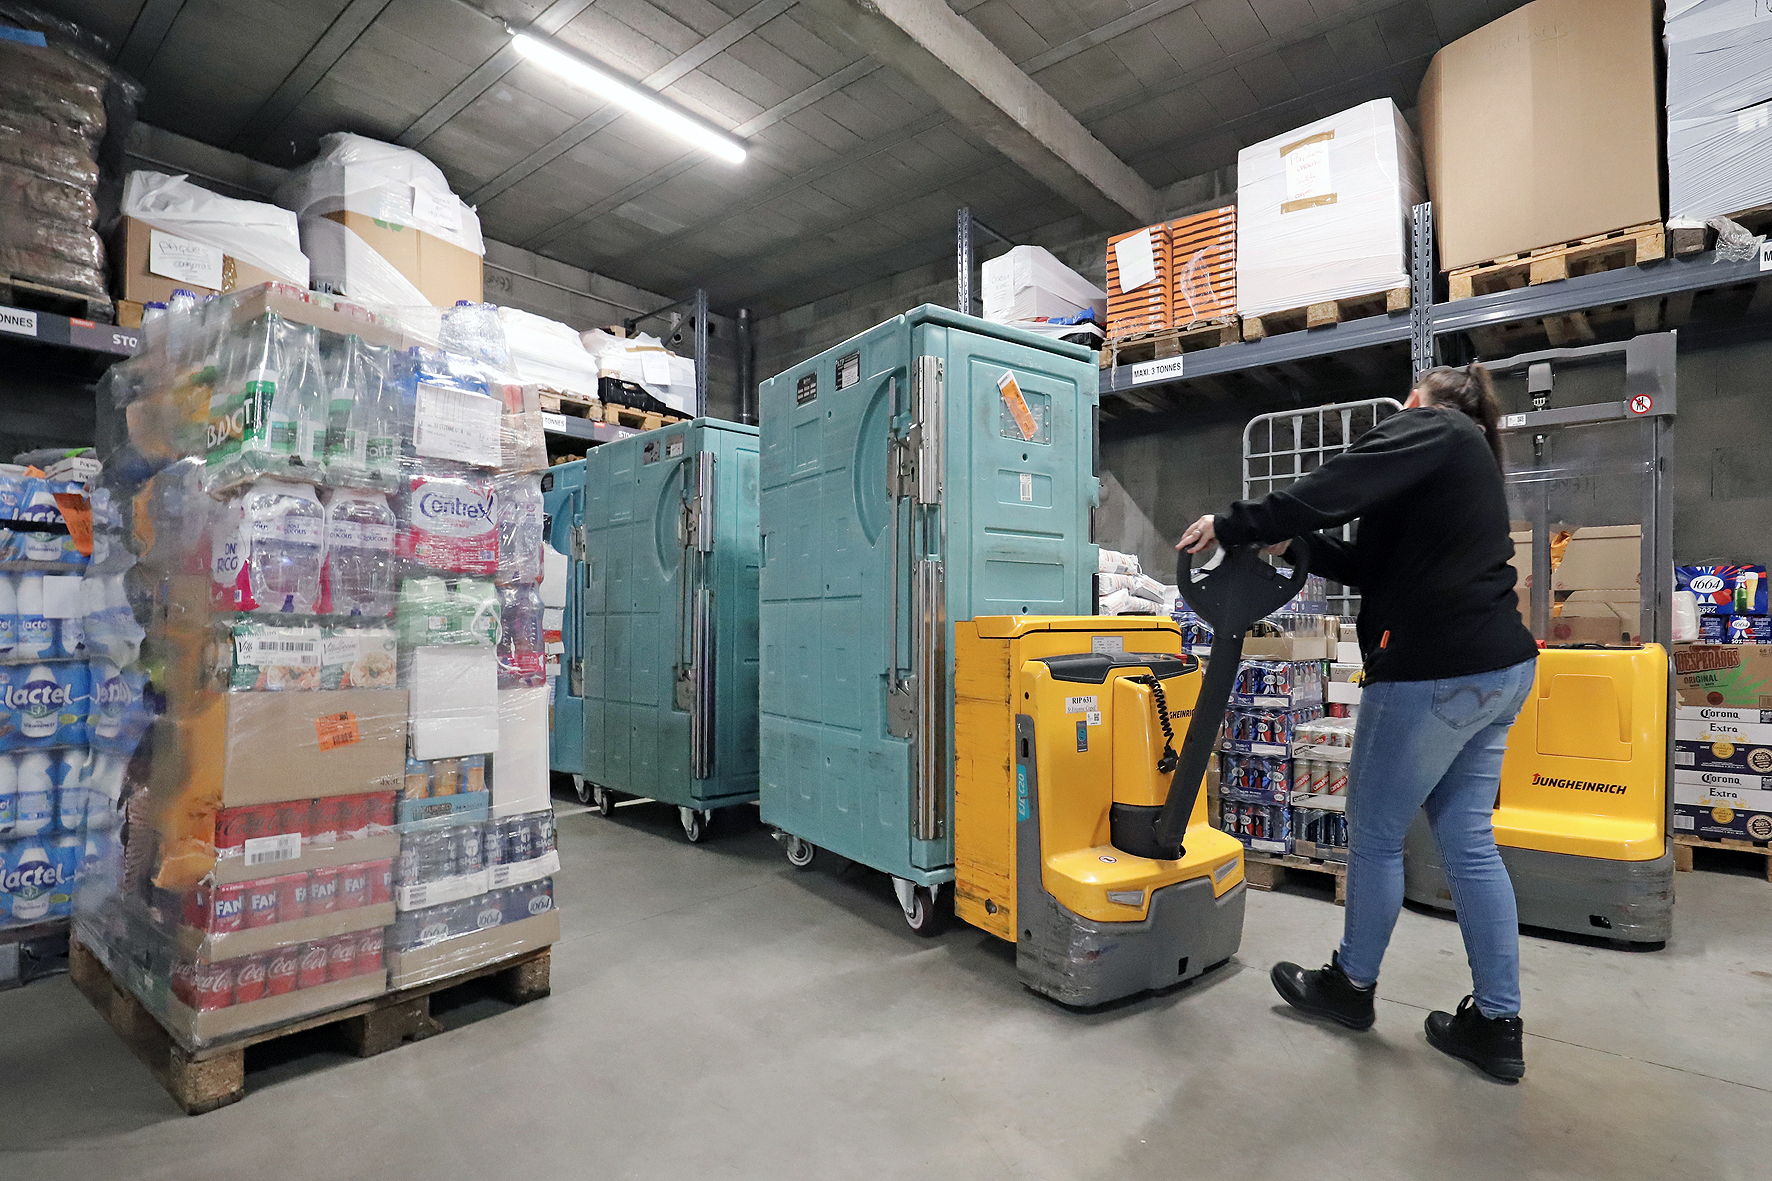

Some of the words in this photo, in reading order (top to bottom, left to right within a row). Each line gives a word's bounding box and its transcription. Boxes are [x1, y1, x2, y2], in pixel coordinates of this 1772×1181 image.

[1151, 367, 1156, 375] 3
[1156, 362, 1182, 374] TONNES
[1692, 580, 1721, 590] 1664
[1677, 650, 1740, 673] DESPERADOS
[1683, 673, 1719, 684] ORIGINAL
[5, 683, 73, 709] lactel
[1072, 697, 1082, 705] RIP
[1700, 708, 1741, 719] Corona
[1709, 723, 1738, 733] Extra
[1701, 773, 1742, 785] Corona
[1532, 775, 1627, 795] JUNGHEINRICH
[1709, 787, 1738, 798] Extra
[0, 863, 66, 893] lactel
